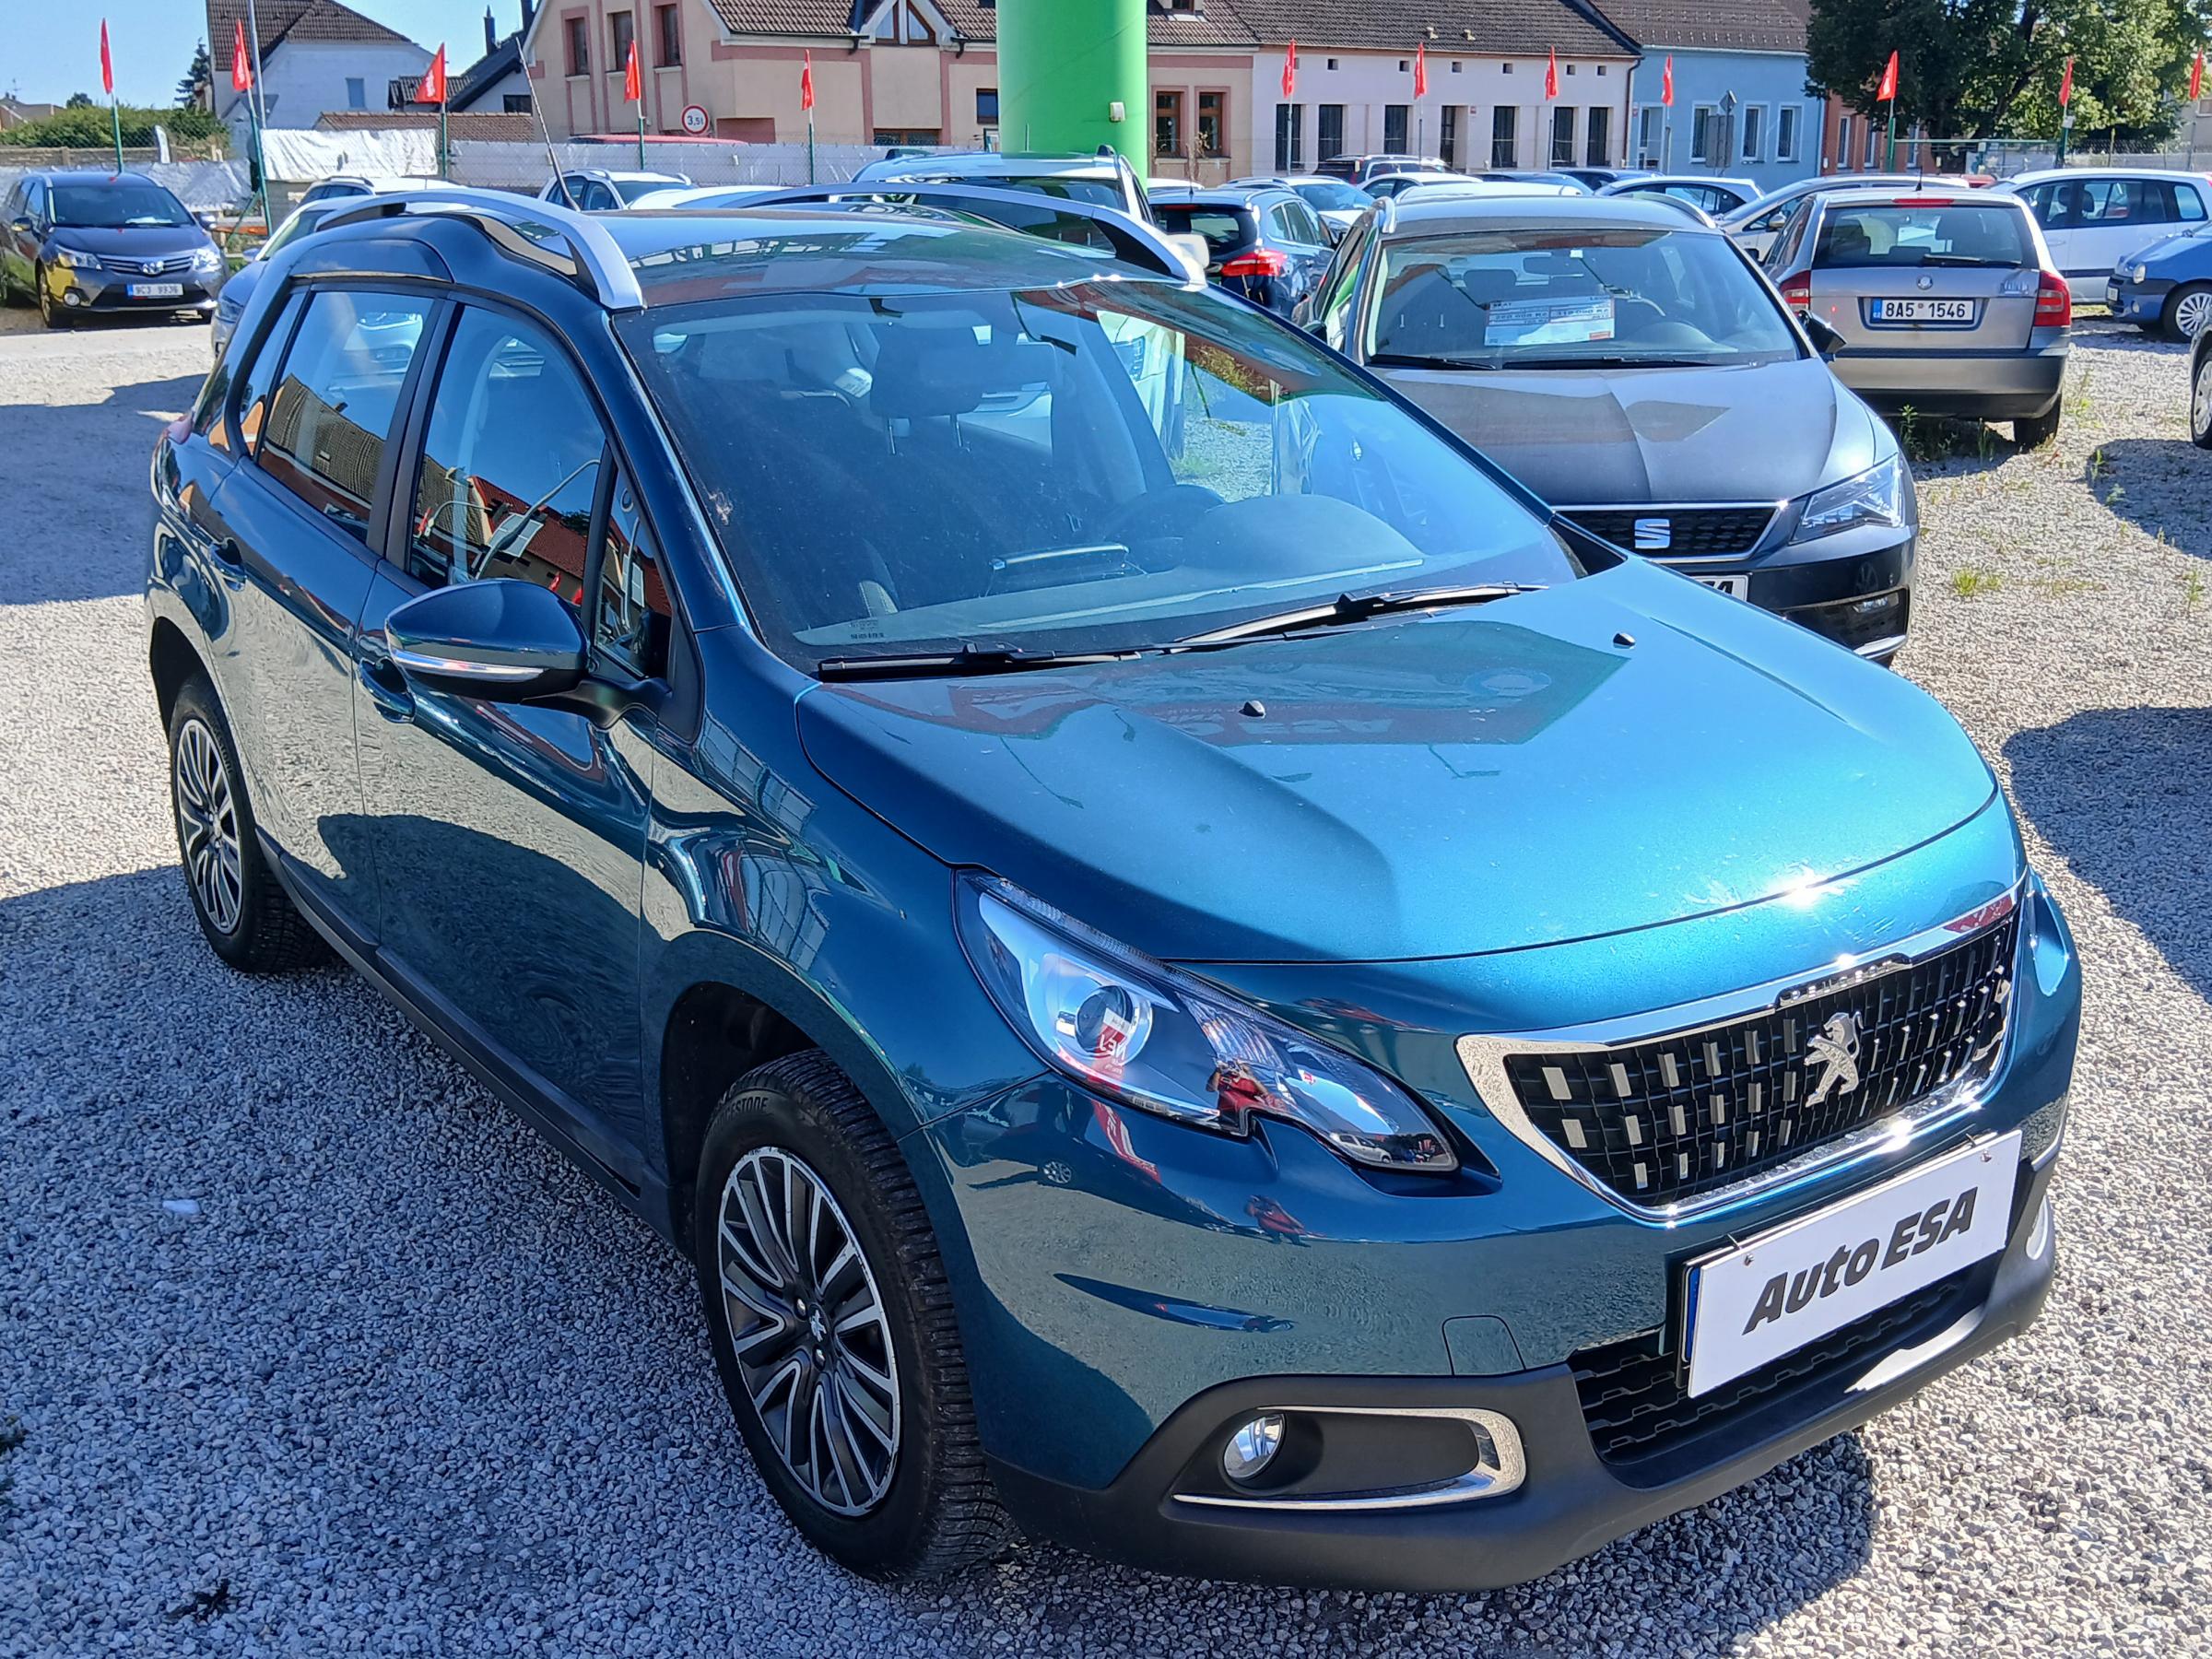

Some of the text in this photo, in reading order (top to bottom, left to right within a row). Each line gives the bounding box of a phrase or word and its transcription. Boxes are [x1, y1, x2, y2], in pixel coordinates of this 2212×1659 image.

[1886, 302, 1966, 318] 8A5 1546
[1742, 1186, 1978, 1335] Auto ESA
